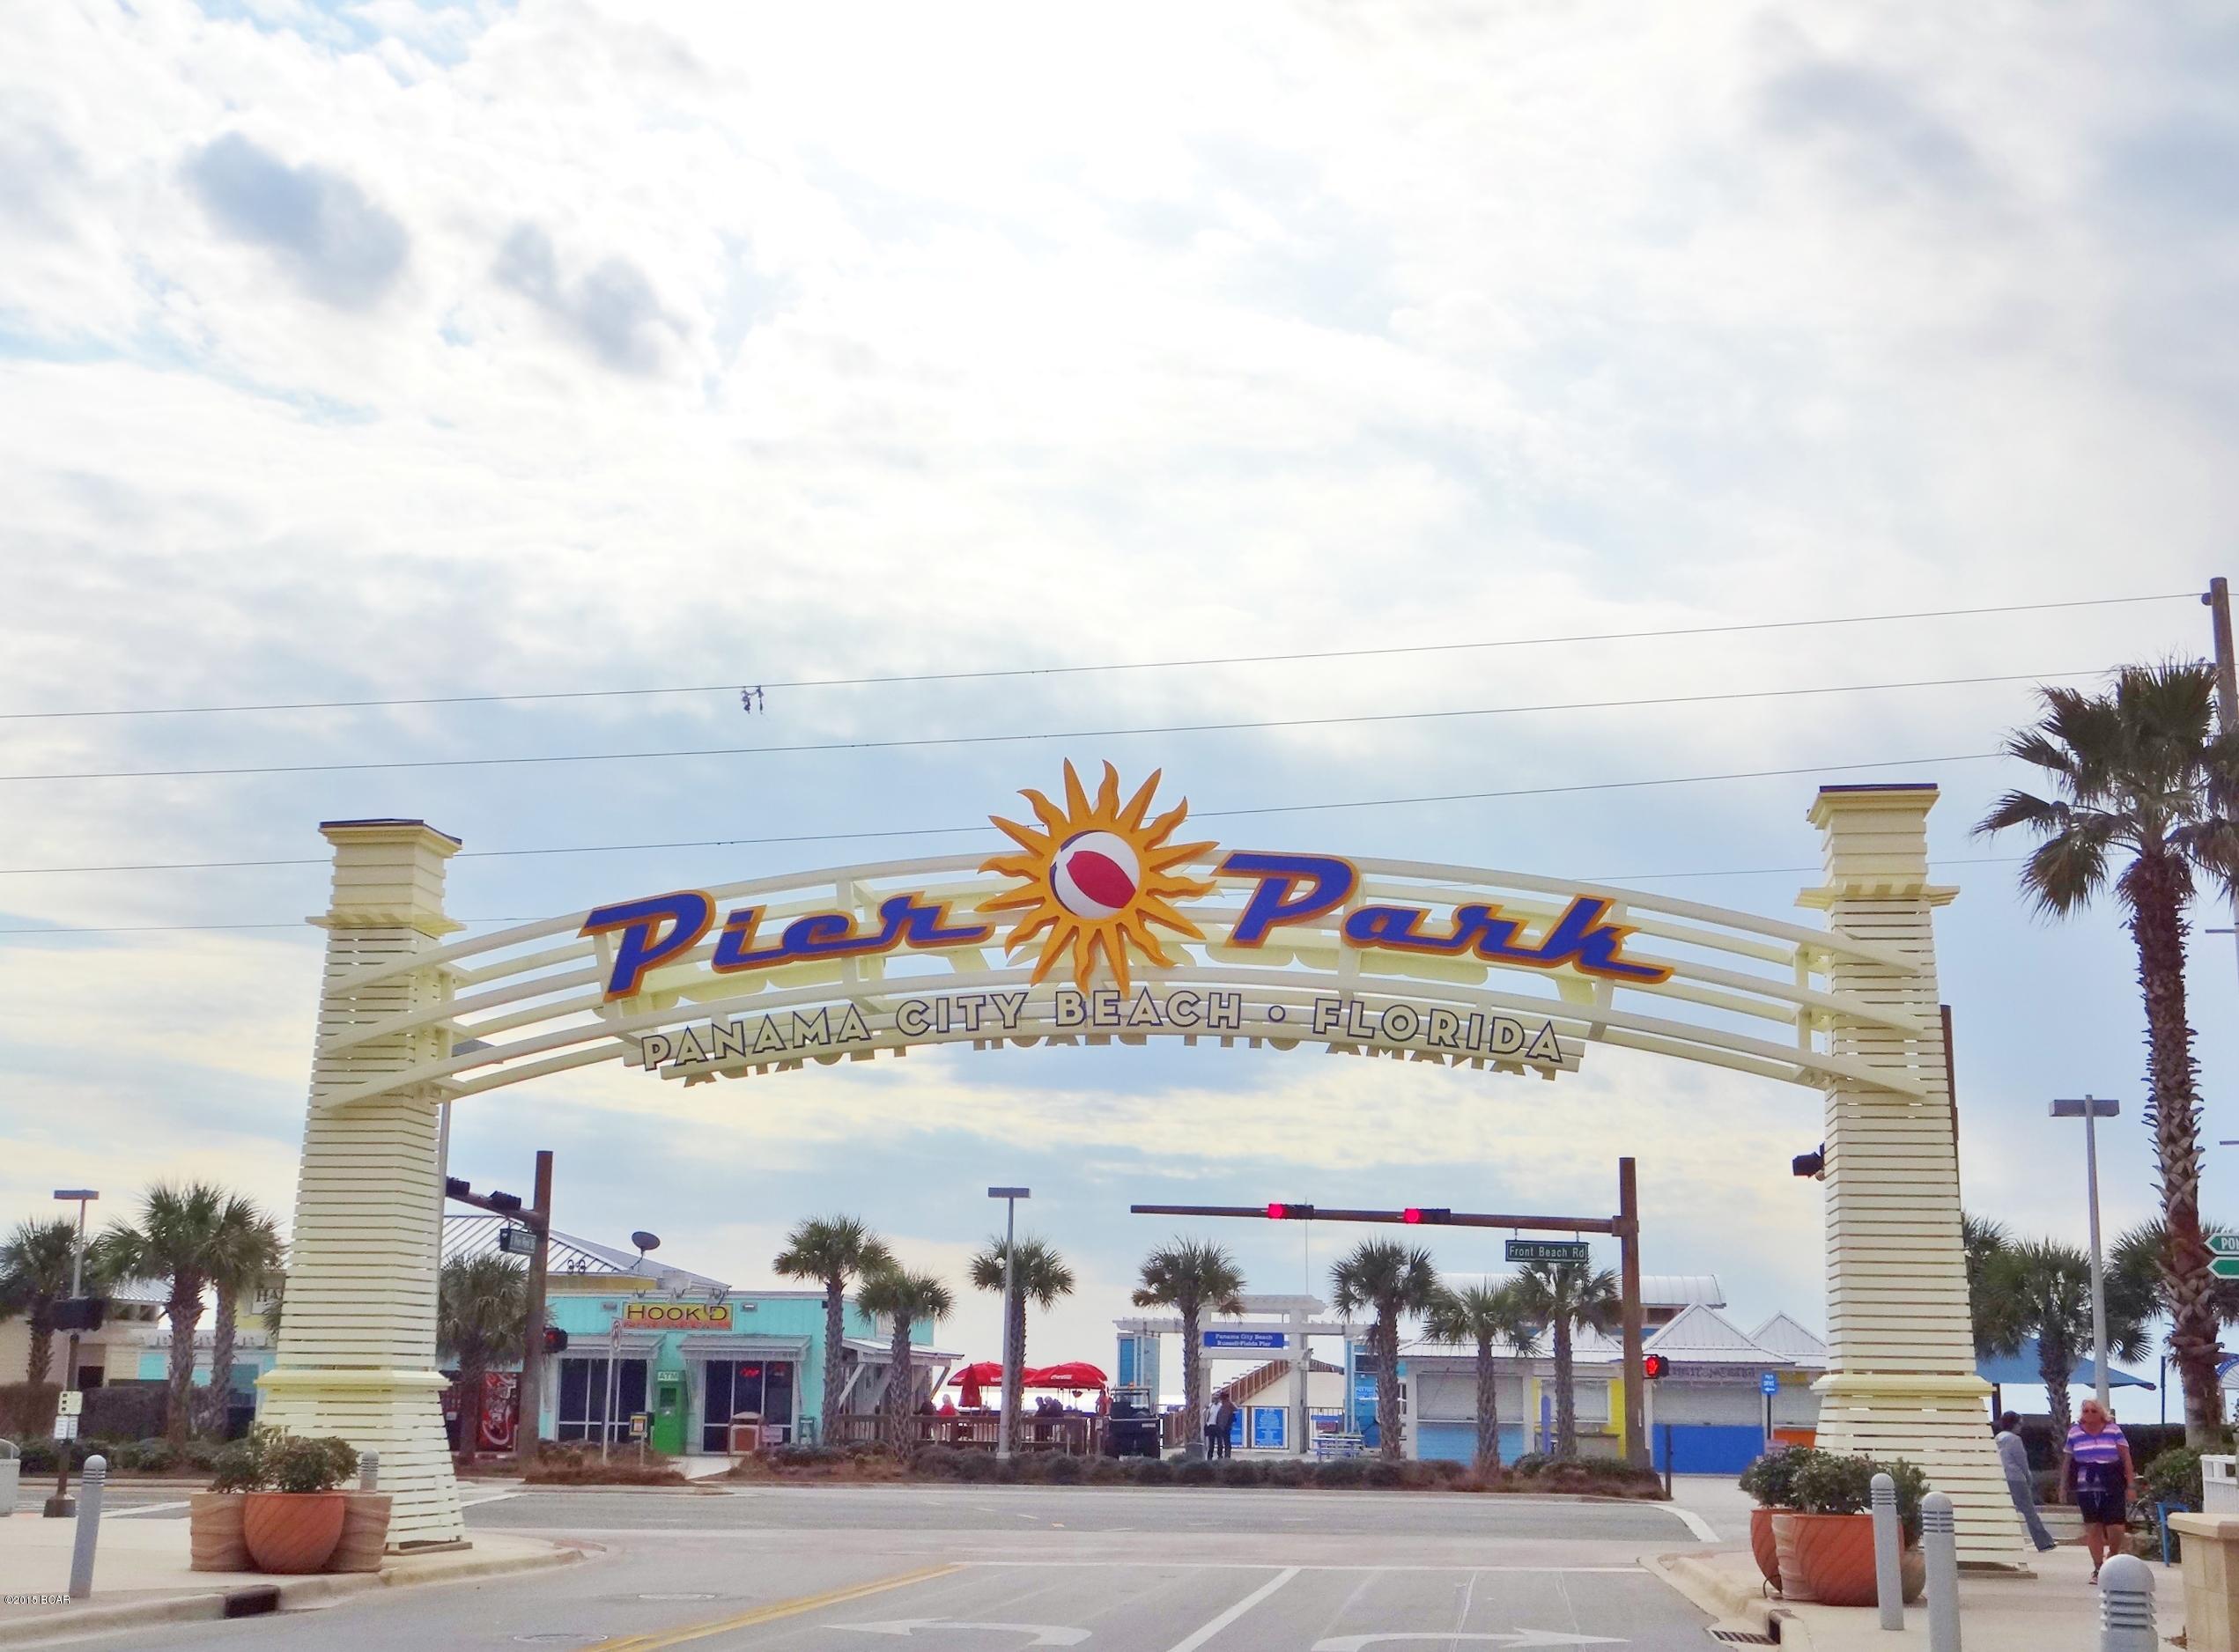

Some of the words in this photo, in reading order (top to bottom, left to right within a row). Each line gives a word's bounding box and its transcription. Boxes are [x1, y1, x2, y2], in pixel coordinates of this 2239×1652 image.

[576, 889, 995, 1002] Pier
[1210, 849, 1673, 985] Park
[641, 1003, 873, 1073] PANAMA
[896, 992, 1029, 1036] CITY
[1055, 987, 1242, 1029] BEACH
[1313, 998, 1563, 1064] FLORIDA
[1509, 1245, 1534, 1257] Front
[1539, 1246, 1568, 1257] Beach
[1572, 1247, 1585, 1257] Rd
[658, 1371, 678, 1381] ATM
